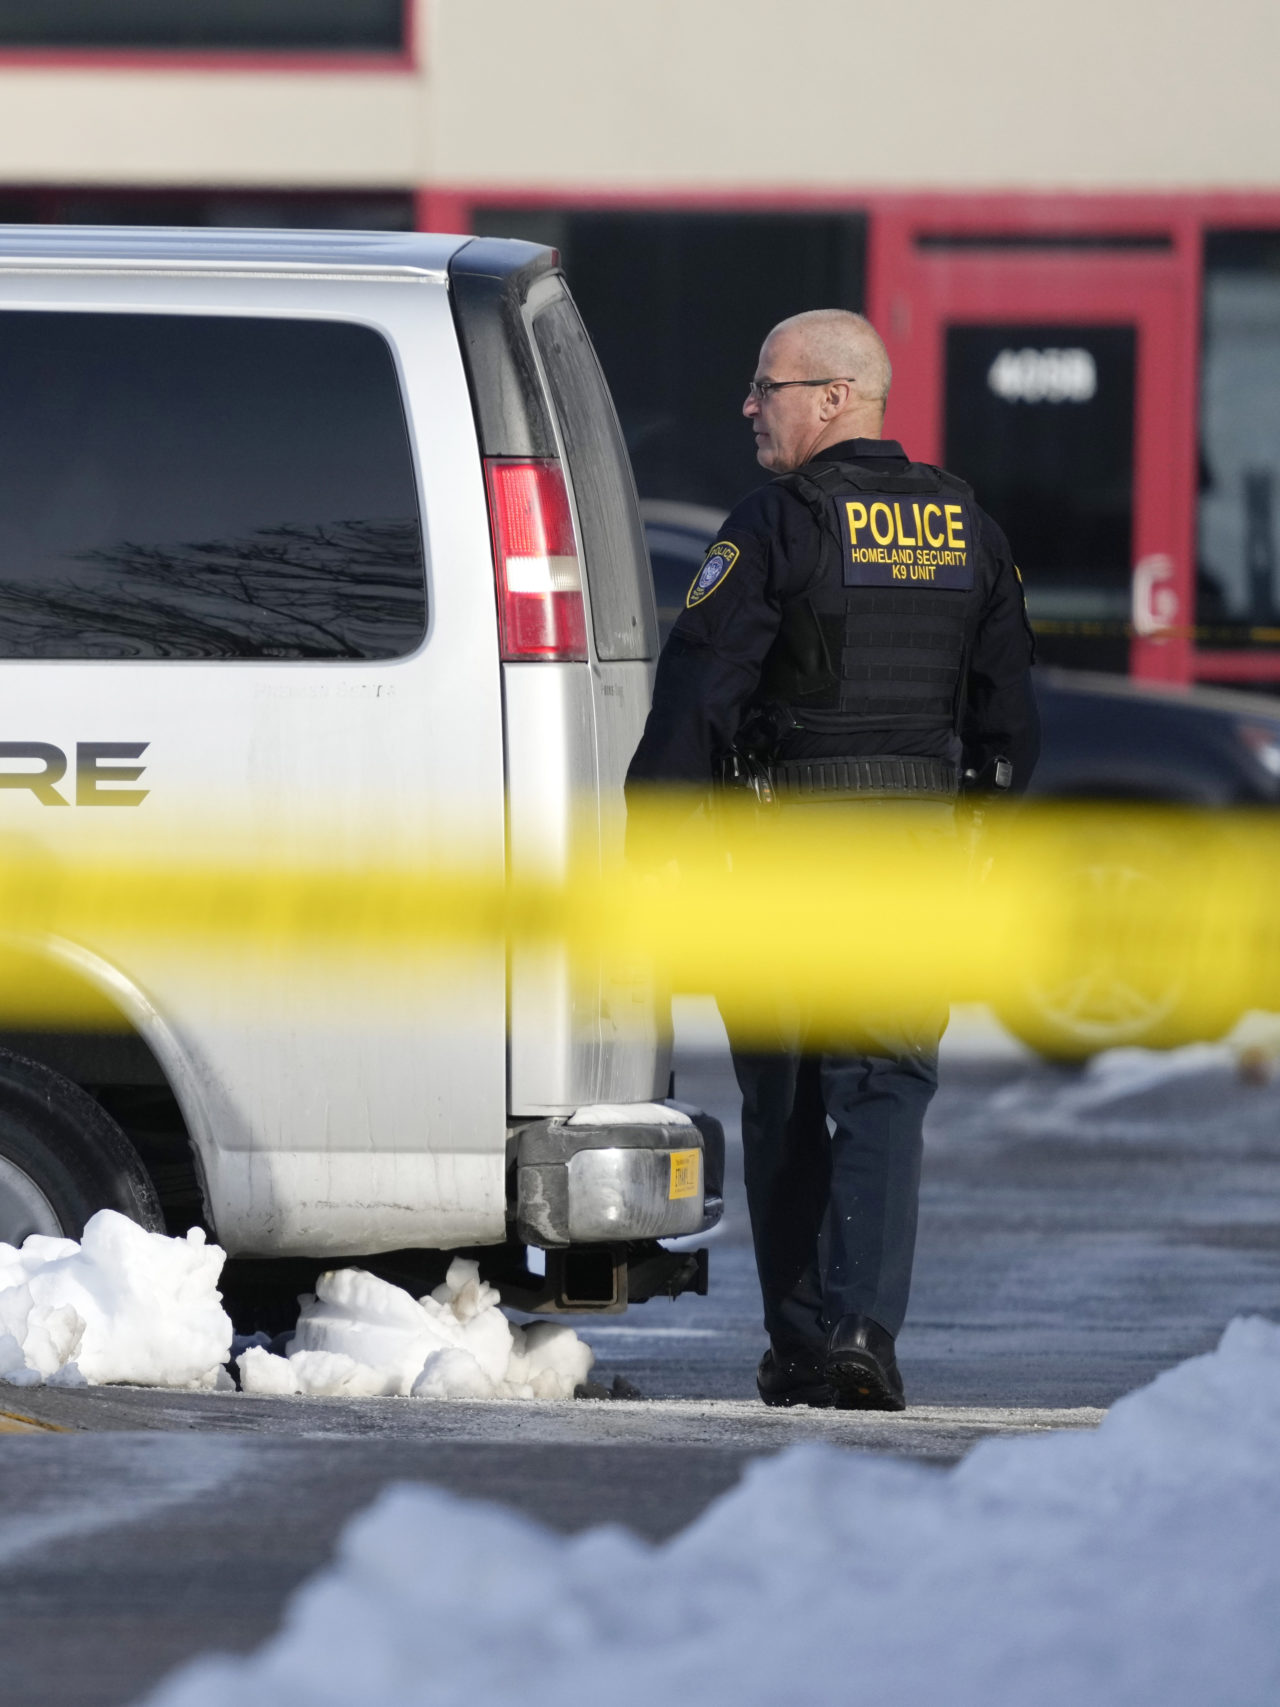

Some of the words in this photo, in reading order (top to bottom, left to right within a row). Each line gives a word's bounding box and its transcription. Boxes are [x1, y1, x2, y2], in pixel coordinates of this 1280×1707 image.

[845, 502, 966, 548] POLICE
[709, 546, 735, 562] POLICE
[851, 548, 914, 564] HOMELAND
[916, 549, 967, 566] SECURITY
[892, 564, 907, 579] K9
[910, 565, 936, 580] UNIT
